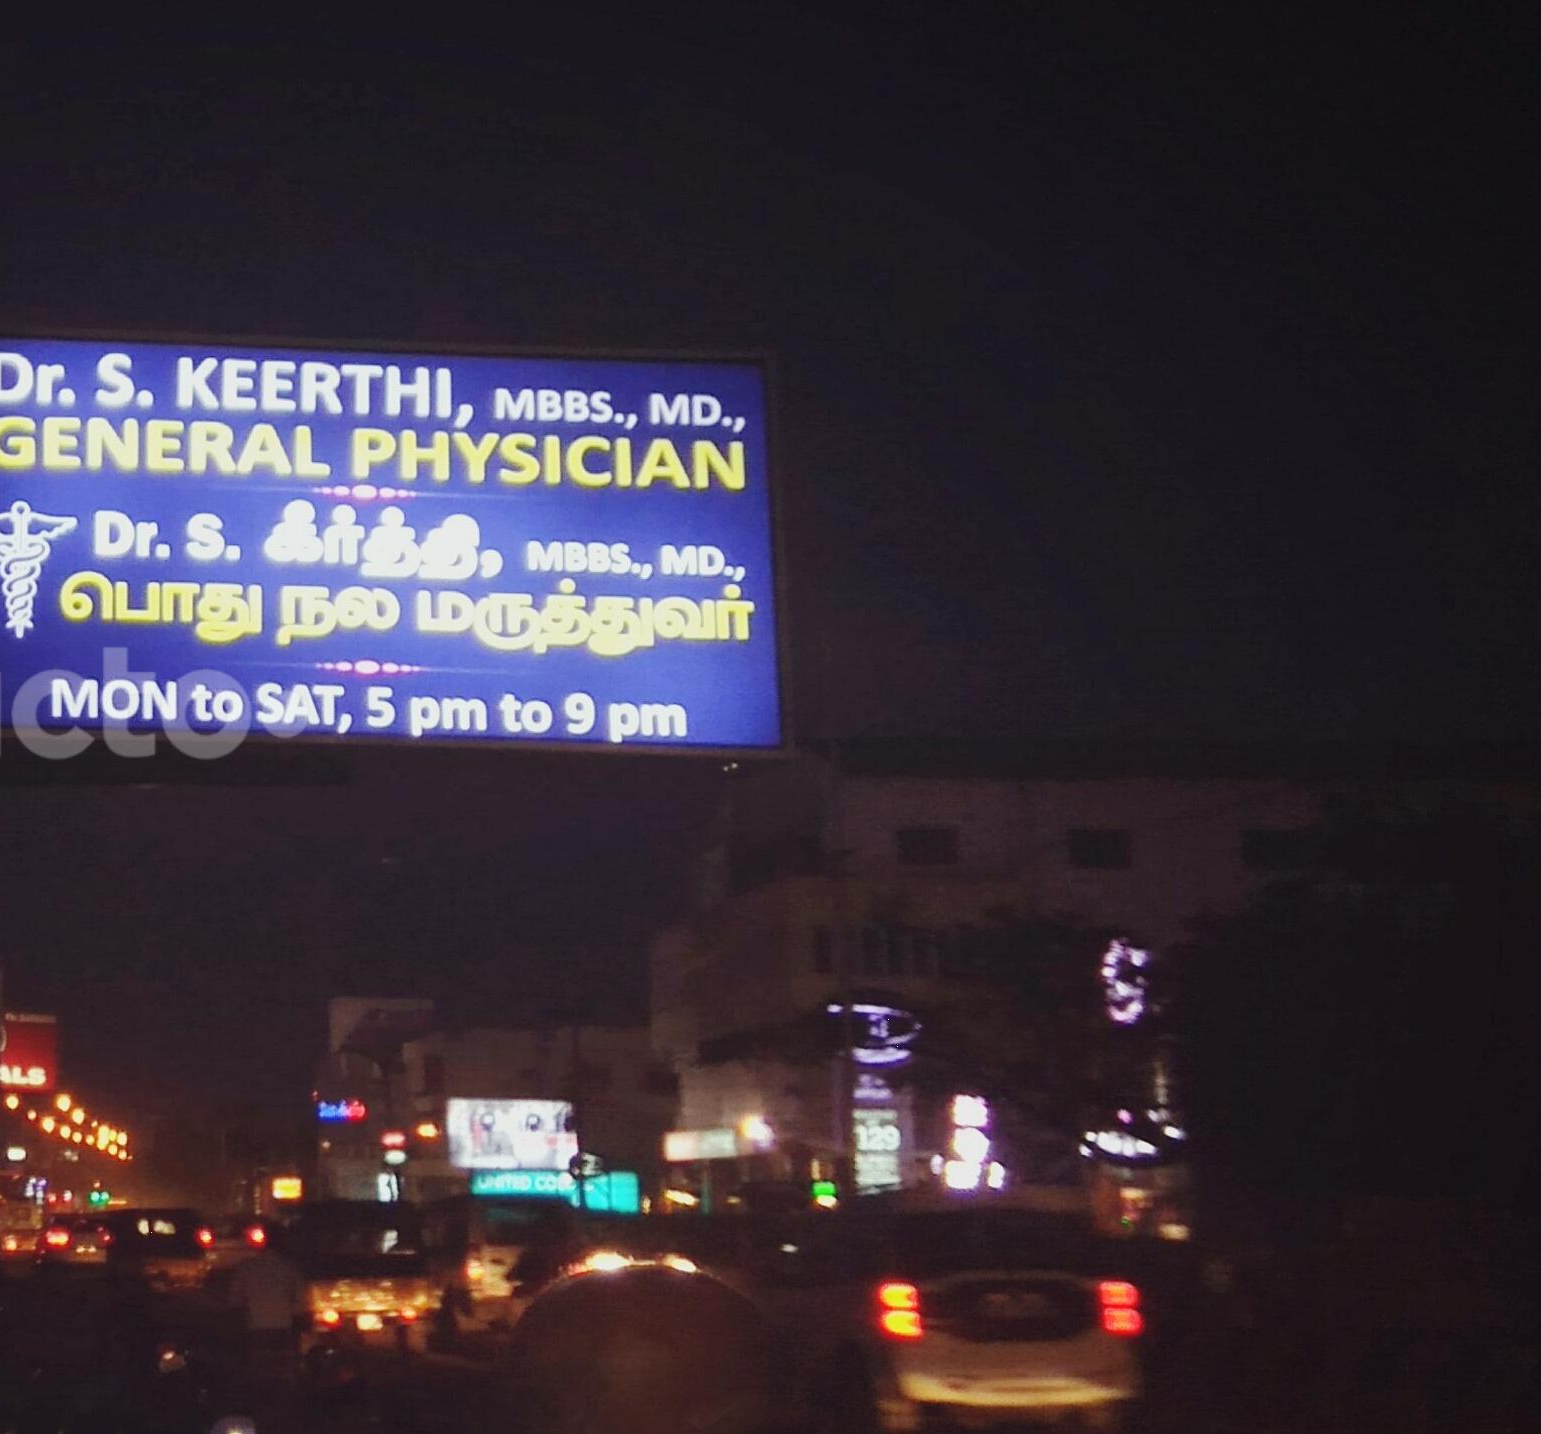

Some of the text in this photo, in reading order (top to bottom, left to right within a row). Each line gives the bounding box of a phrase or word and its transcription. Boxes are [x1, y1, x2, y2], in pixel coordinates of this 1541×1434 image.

[95, 353, 155, 409] S.
[176, 356, 474, 428] KEERTHI,
[494, 387, 638, 429] MBBS.,
[649, 392, 746, 432] MD.,
[352, 428, 746, 490] PHYSICIAN
[94, 499, 746, 582] Dr. S. கீர்த்தி, MBBS., MD.,
[60, 570, 755, 656] பொது நல மருத்துவர்
[49, 677, 689, 743] MON to SAT, 5 pm to 9 pm
